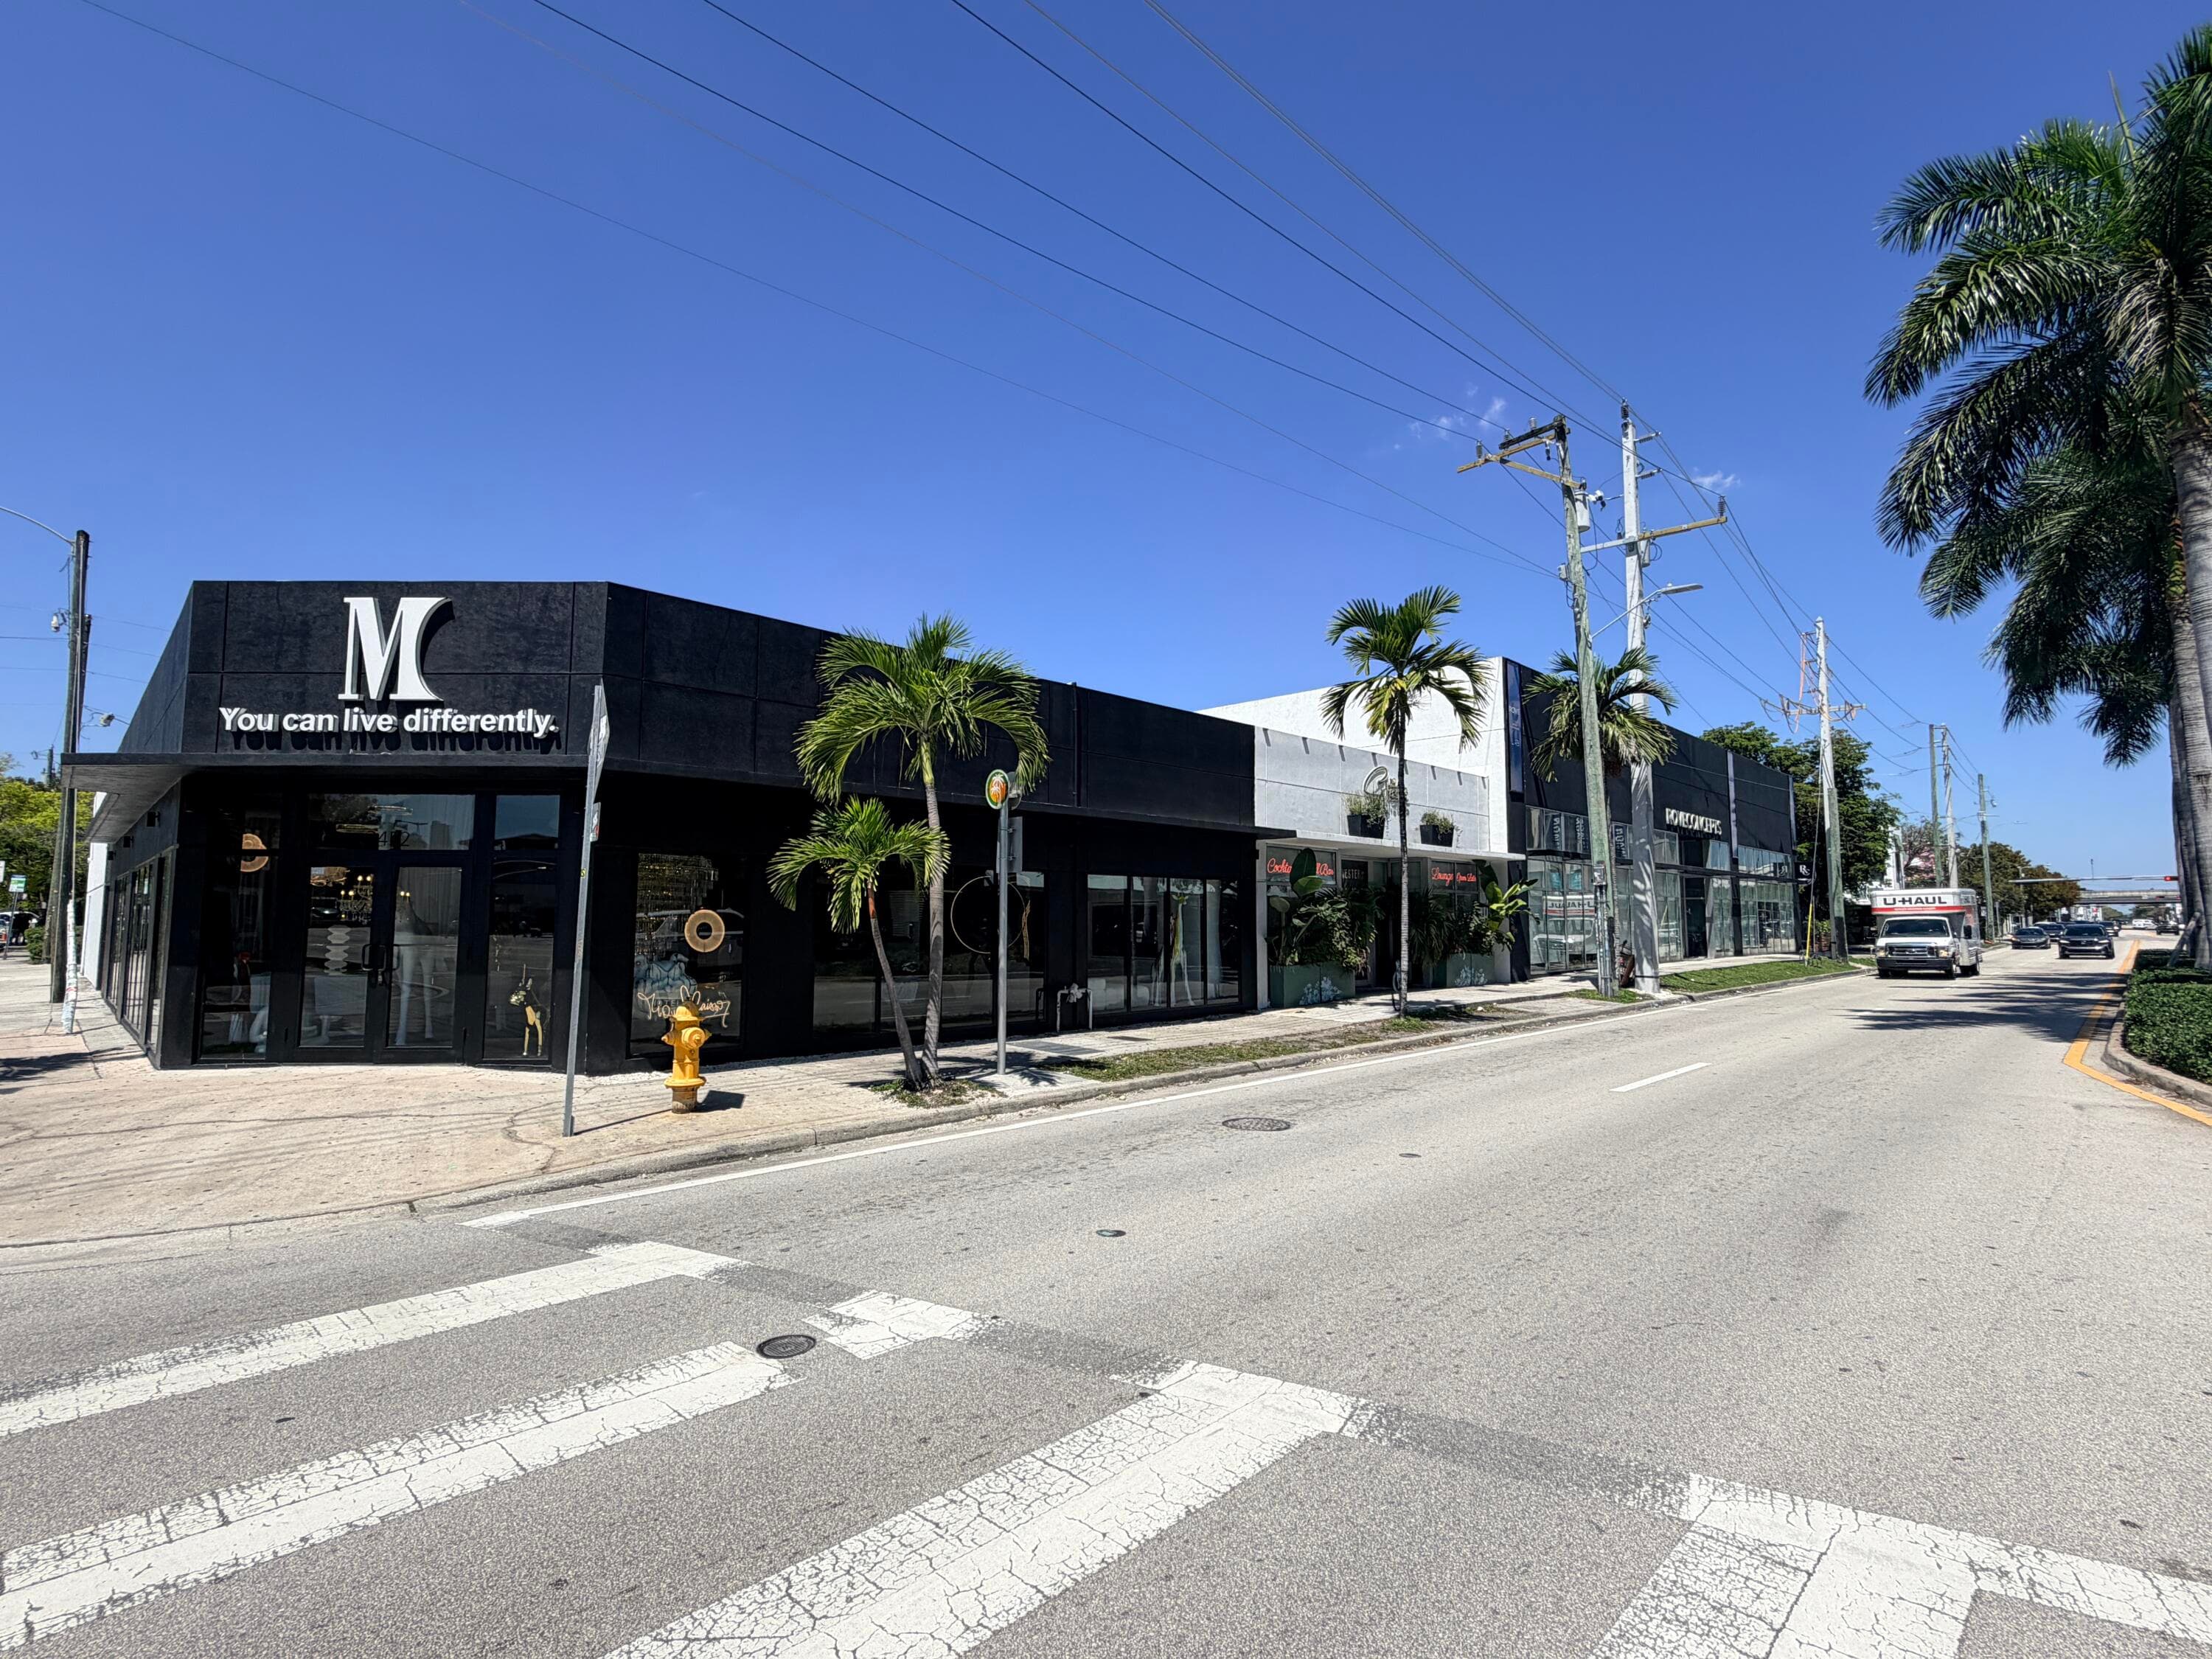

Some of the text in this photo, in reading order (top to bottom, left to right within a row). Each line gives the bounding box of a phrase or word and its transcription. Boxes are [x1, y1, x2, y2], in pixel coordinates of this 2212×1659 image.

[219, 706, 557, 738] You can live differently.
[378, 830, 410, 847] 42
[1883, 896, 1947, 905] U-HAUL
